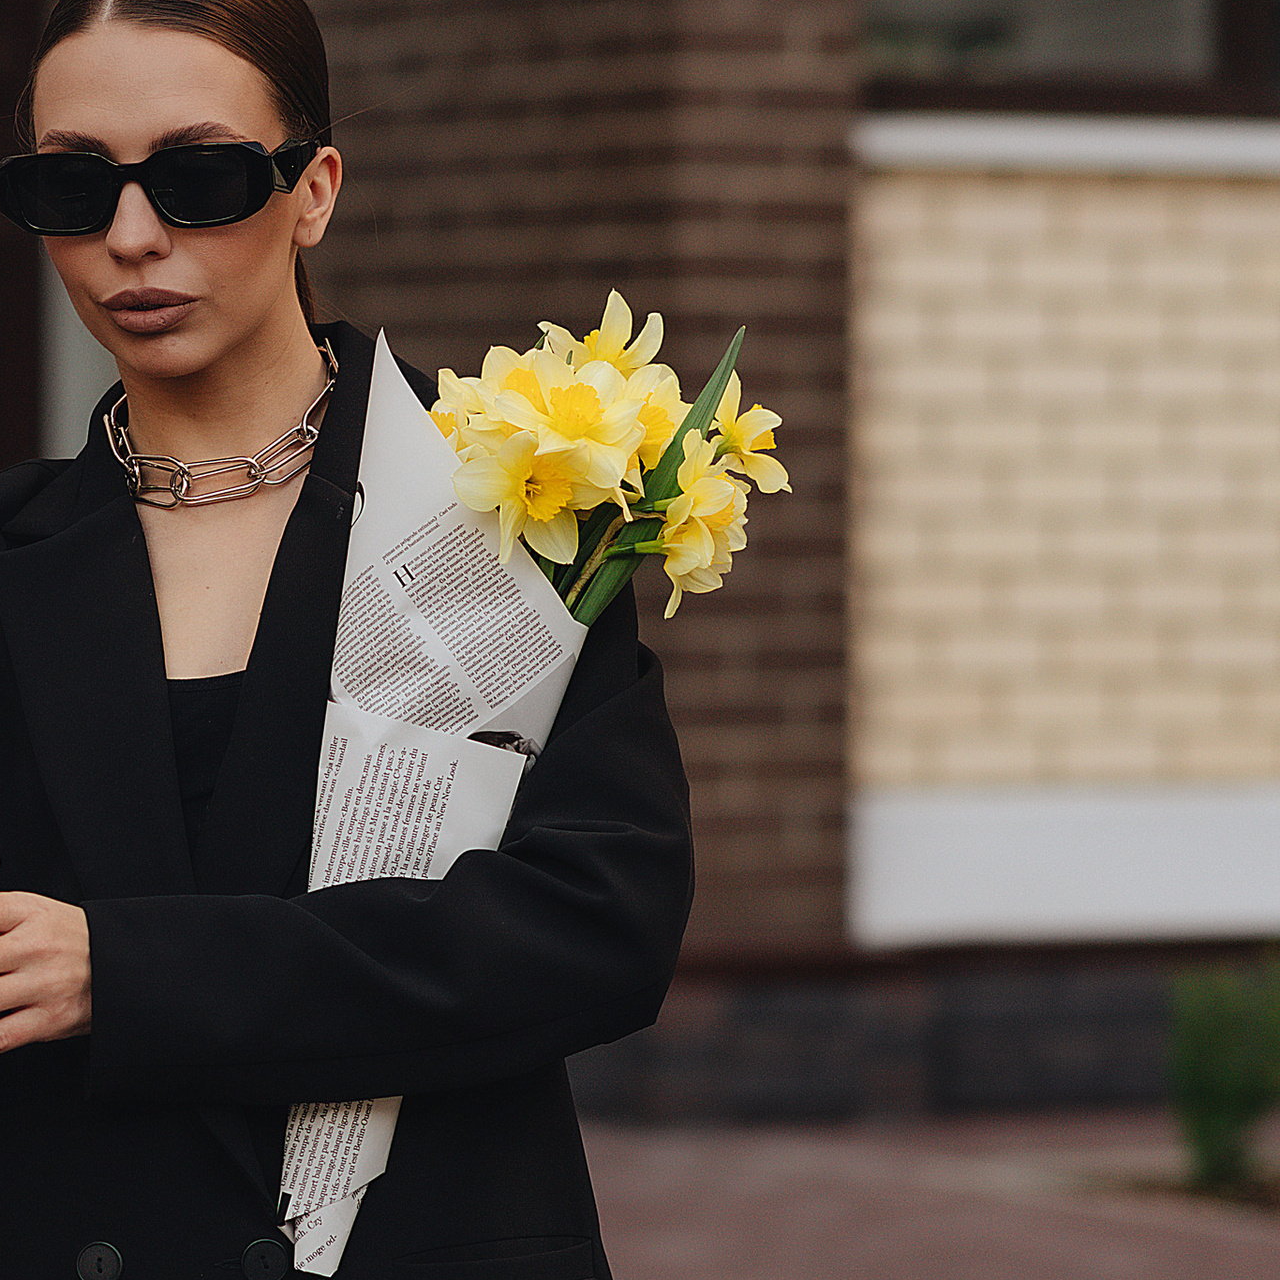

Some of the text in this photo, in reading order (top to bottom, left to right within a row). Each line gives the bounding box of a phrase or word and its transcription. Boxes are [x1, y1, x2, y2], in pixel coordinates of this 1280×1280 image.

[328, 736, 338, 761] titiller
[324, 762, 333, 779] deja
[415, 753, 428, 781] veulent
[446, 760, 458, 781] Look.
[318, 780, 328, 807] venant
[353, 807, 370, 843] buildings
[364, 743, 388, 805] ultra-modernes,
[375, 772, 390, 808] n'existait
[413, 783, 420, 793] ne
[441, 782, 452, 801] New
[323, 794, 332, 813] dans
[380, 843, 393, 875] possede
[387, 834, 395, 842] la
[391, 810, 401, 833] mode
[409, 748, 418, 759] du
[402, 794, 416, 825] femmes
[436, 801, 447, 820] New
[347, 807, 358, 835] coupee
[355, 796, 362, 806] en
[369, 809, 380, 826] Mur
[377, 821, 388, 844] passe
[383, 806, 392, 814] la
[400, 863, 409, 871] la
[405, 825, 419, 862] meilleure
[415, 791, 429, 824] maniere
[423, 780, 432, 790] de
[424, 813, 433, 823] de
[366, 827, 375, 835] le
[435, 821, 442, 832] au
[365, 836, 373, 844] si
[395, 827, 408, 854] jeunes
[416, 824, 430, 856] changer
[413, 857, 421, 871] par
[337, 1110, 350, 1130] ligne
[353, 1102, 373, 1151] Berlin-Ouest
[324, 1125, 334, 1139] des
[289, 1164, 301, 1190] menee
[299, 1135, 310, 1157] coups
[305, 1124, 312, 1134] de
[321, 1139, 330, 1154] par
[344, 1146, 351, 1156] en
[280, 1169, 289, 1187] Une
[286, 1142, 297, 1170] rivalite
[311, 1154, 326, 1179] balaye
[348, 1153, 359, 1175] qu'est
[298, 1166, 311, 1200] couleurs
[308, 1180, 319, 1199] mort
[305, 1245, 325, 1263] moge
